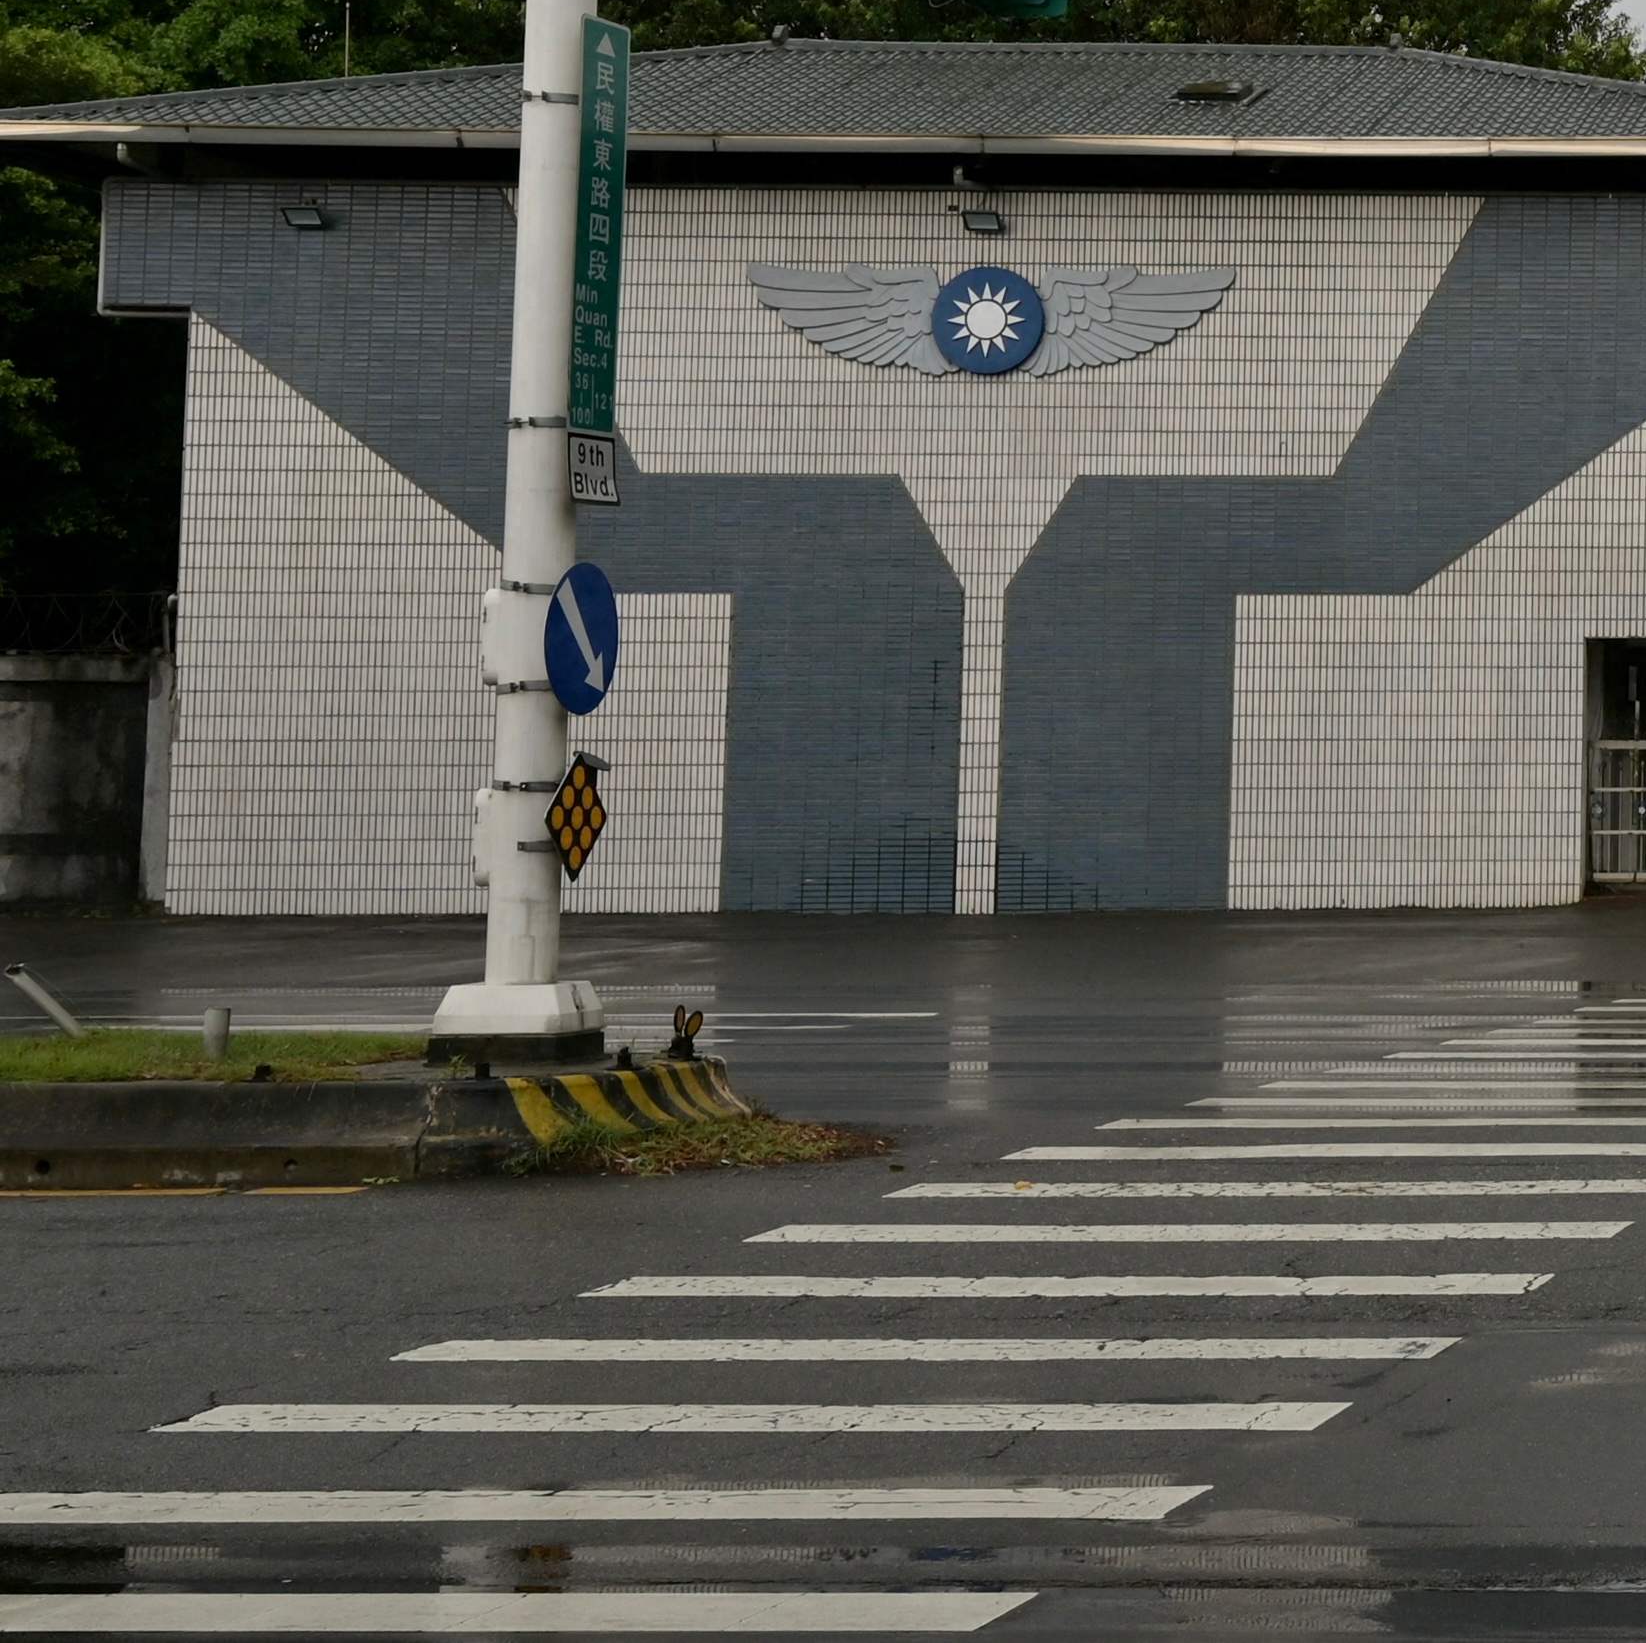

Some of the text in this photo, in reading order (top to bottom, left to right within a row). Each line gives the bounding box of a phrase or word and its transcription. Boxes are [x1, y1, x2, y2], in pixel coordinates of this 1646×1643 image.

[587, 61, 615, 282] 民權東路四段
[576, 282, 598, 304] Min
[575, 305, 608, 327] Quan
[574, 326, 614, 349] E. Rd.
[575, 371, 589, 390] 36
[572, 406, 591, 425] 100
[577, 443, 605, 467] 9th
[574, 472, 614, 497] Blvd.
